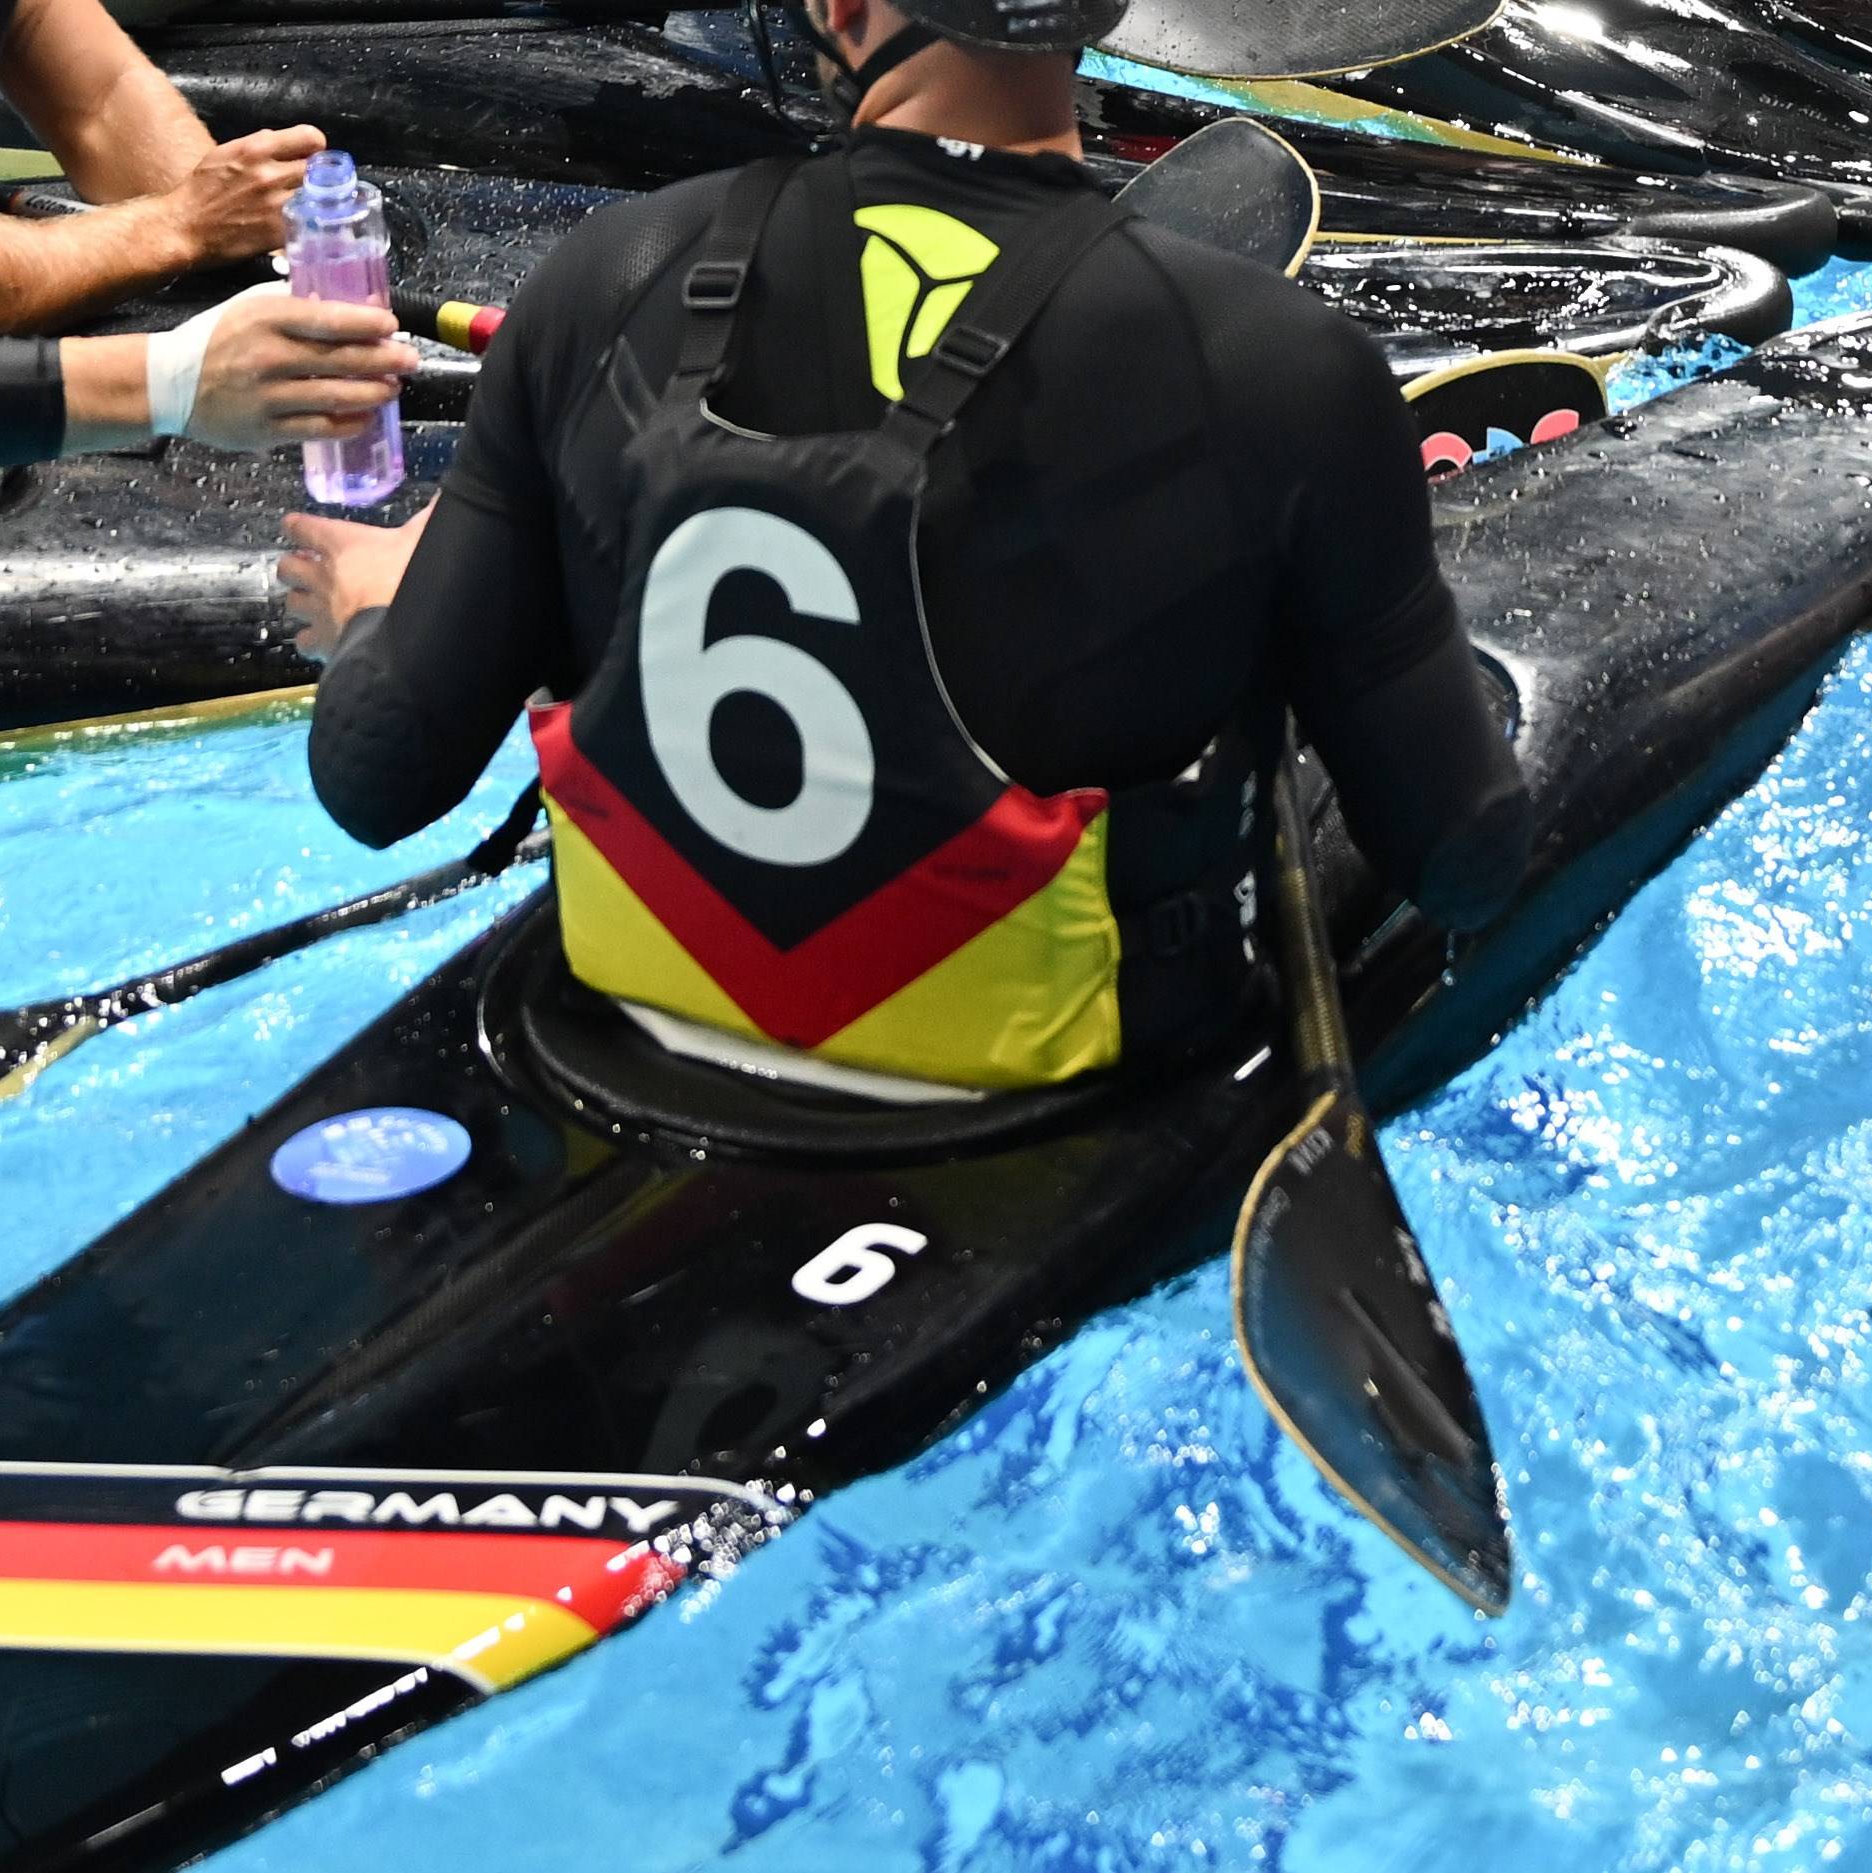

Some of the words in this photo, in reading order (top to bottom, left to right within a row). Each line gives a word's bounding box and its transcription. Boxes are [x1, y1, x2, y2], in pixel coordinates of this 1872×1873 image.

[638, 507, 876, 866] 6
[791, 1222, 928, 1305] 6
[174, 1488, 683, 1534] GERMANY
[151, 1543, 336, 1576] MEN
